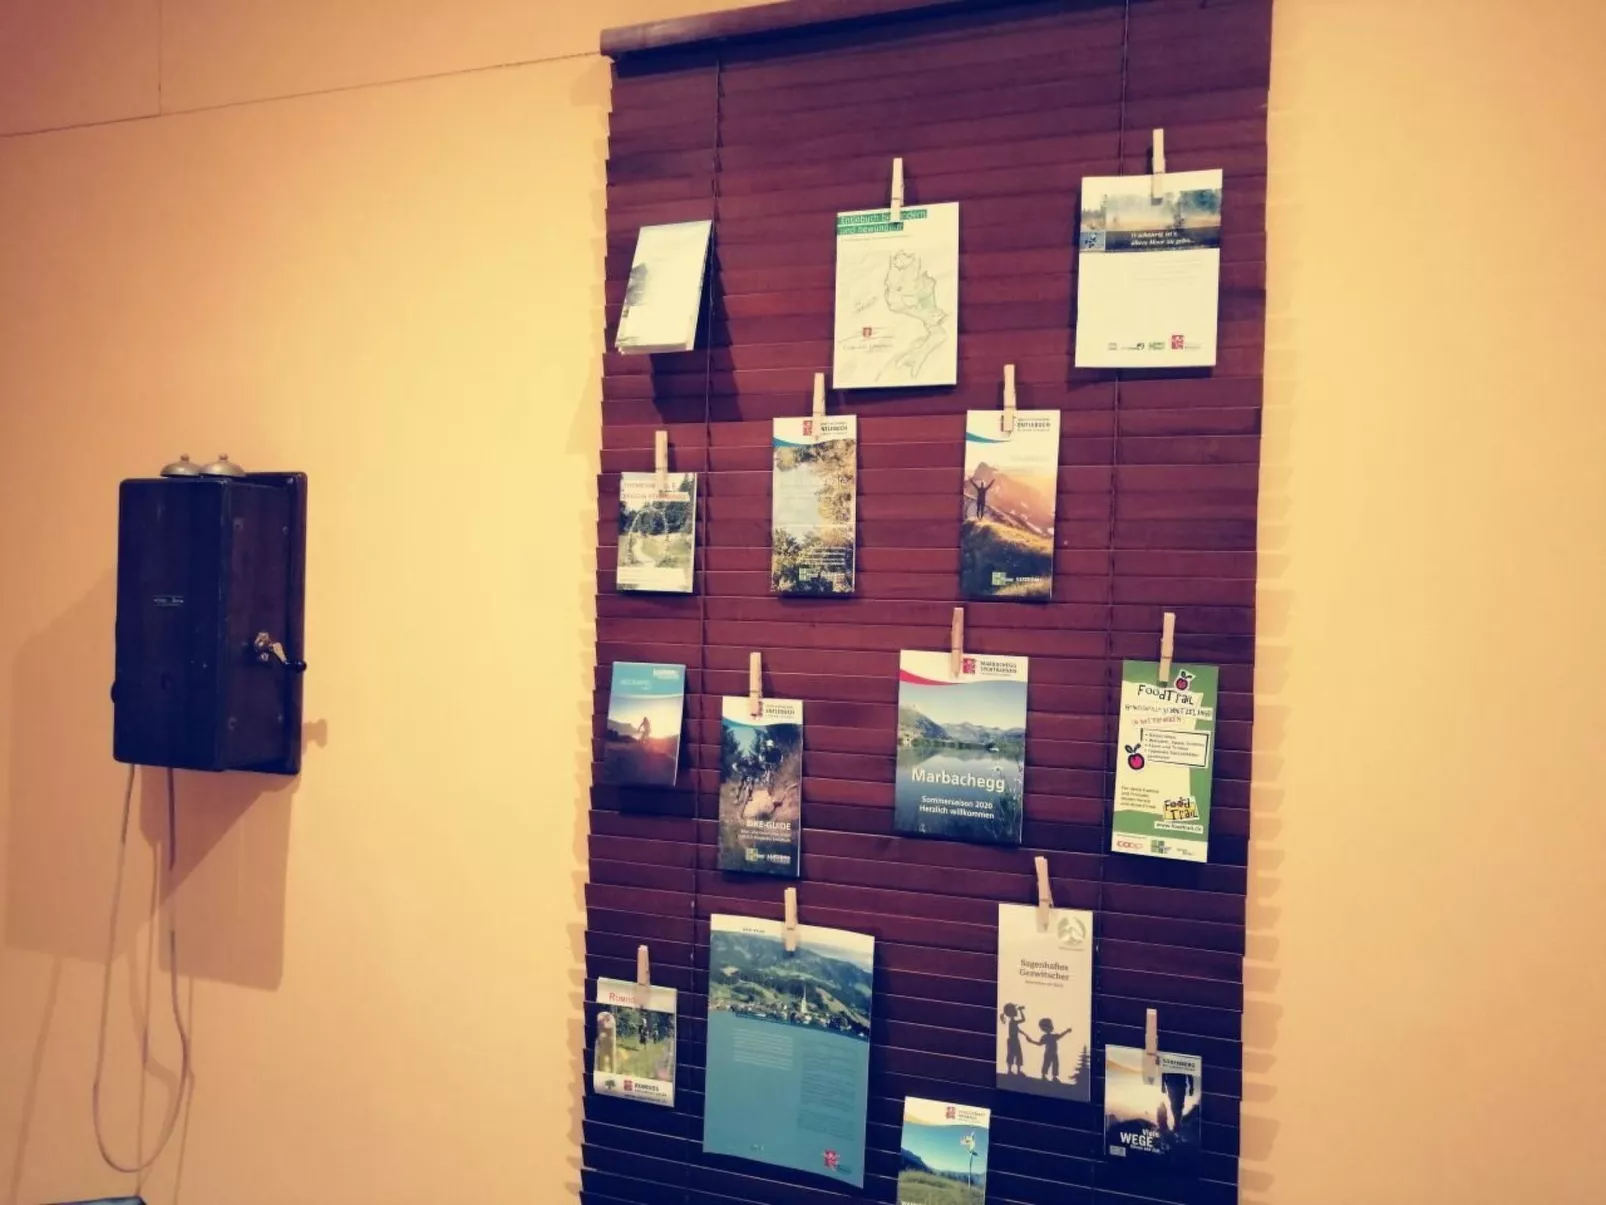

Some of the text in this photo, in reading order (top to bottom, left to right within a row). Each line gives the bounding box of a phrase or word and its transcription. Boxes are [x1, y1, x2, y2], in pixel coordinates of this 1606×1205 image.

[911, 767, 1006, 794] Marbachegg
[921, 795, 993, 810] Sommersaison 2020
[919, 805, 995, 820] Herzlich willkommen
[746, 820, 792, 832] BIKE-GUIDE
[1020, 959, 1069, 972] Sagenhaftes
[1119, 1131, 1154, 1148] WEGE
